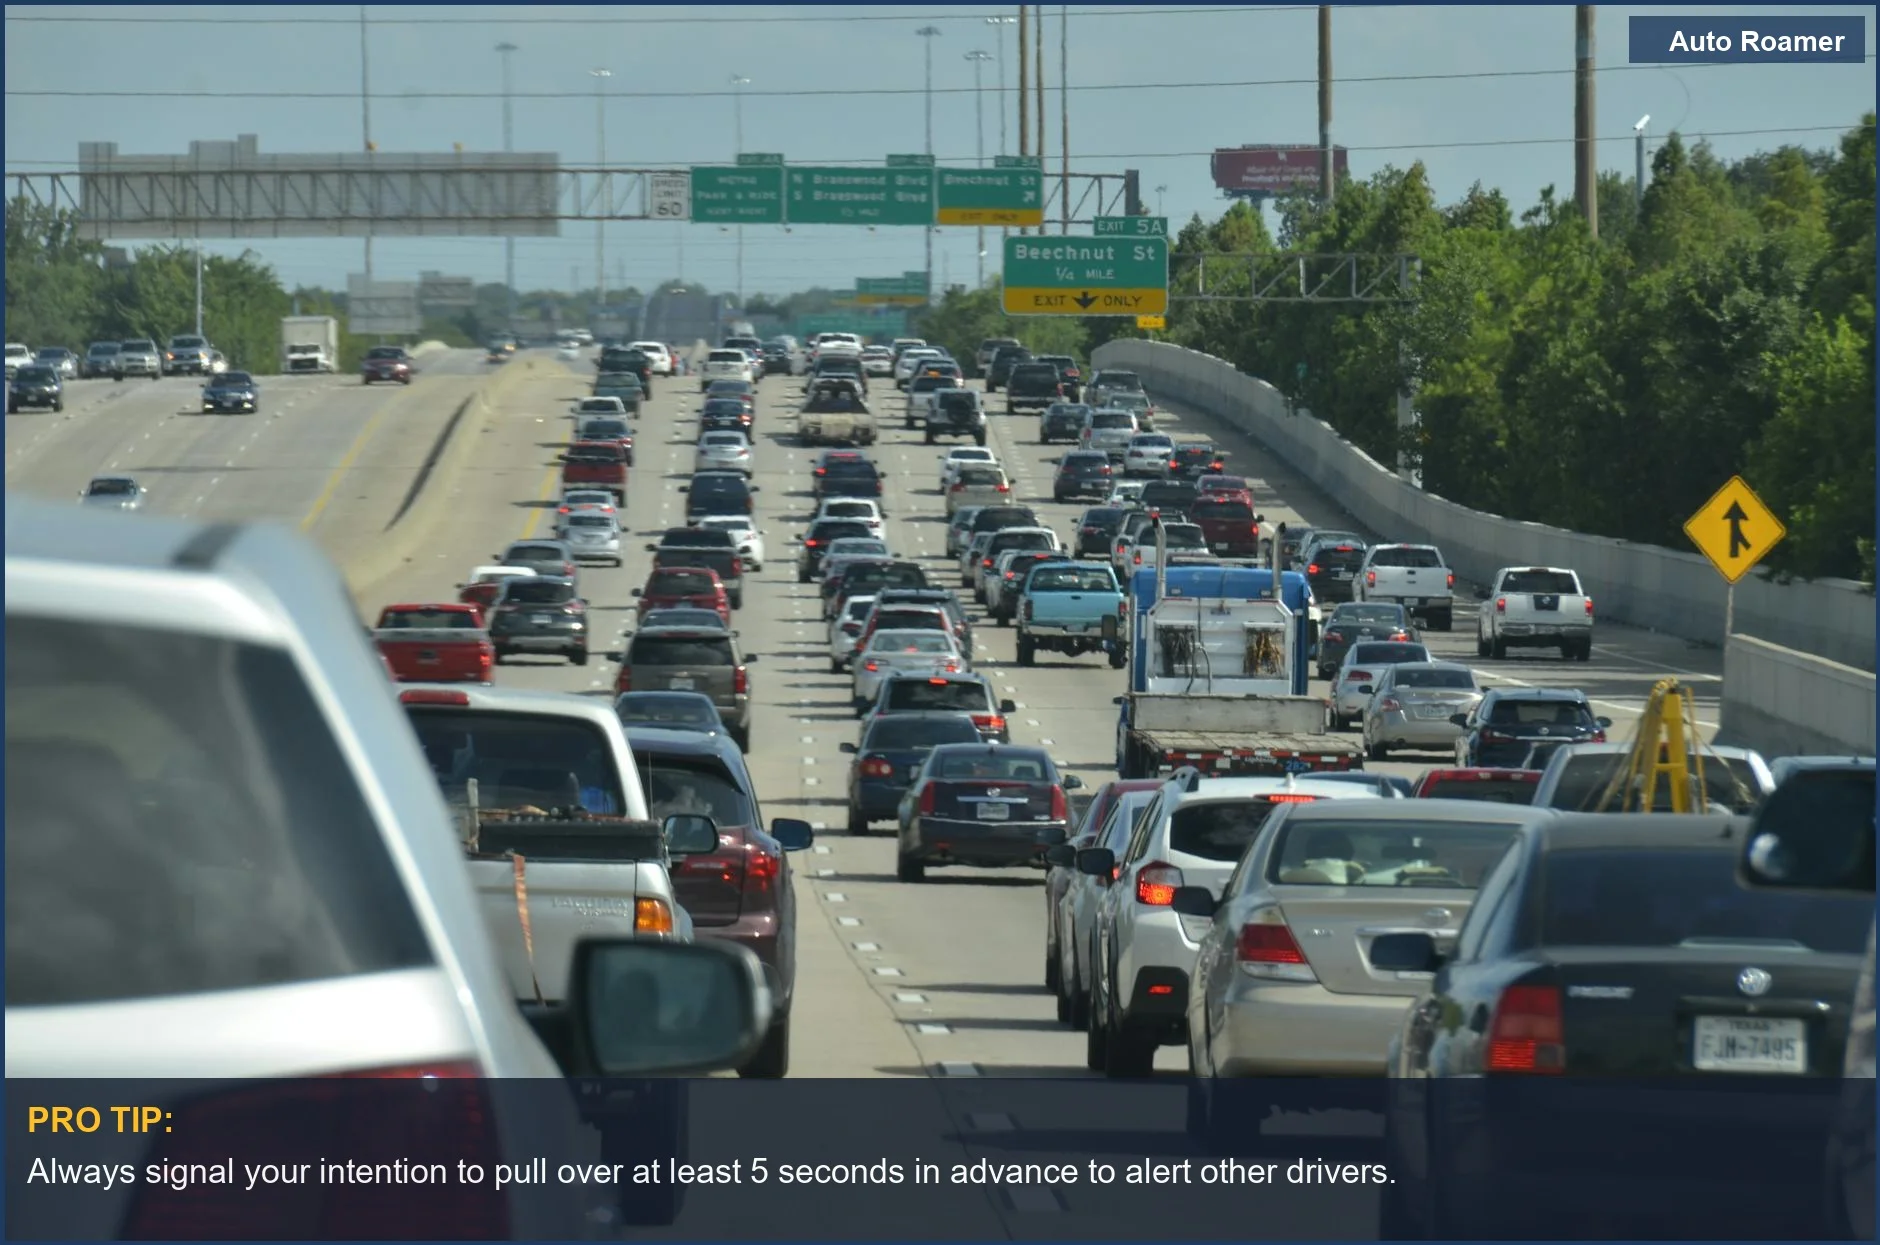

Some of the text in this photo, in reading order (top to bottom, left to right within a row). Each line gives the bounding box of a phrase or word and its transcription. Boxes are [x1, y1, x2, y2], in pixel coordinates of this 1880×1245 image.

[944, 174, 1009, 186] Beechnut
[656, 201, 683, 217] 60
[1097, 218, 1163, 235] EXIT 5A
[1015, 244, 1156, 261] Beechnut St
[1086, 269, 1115, 280] MILE
[1033, 295, 1143, 307] EXIT ONLY
